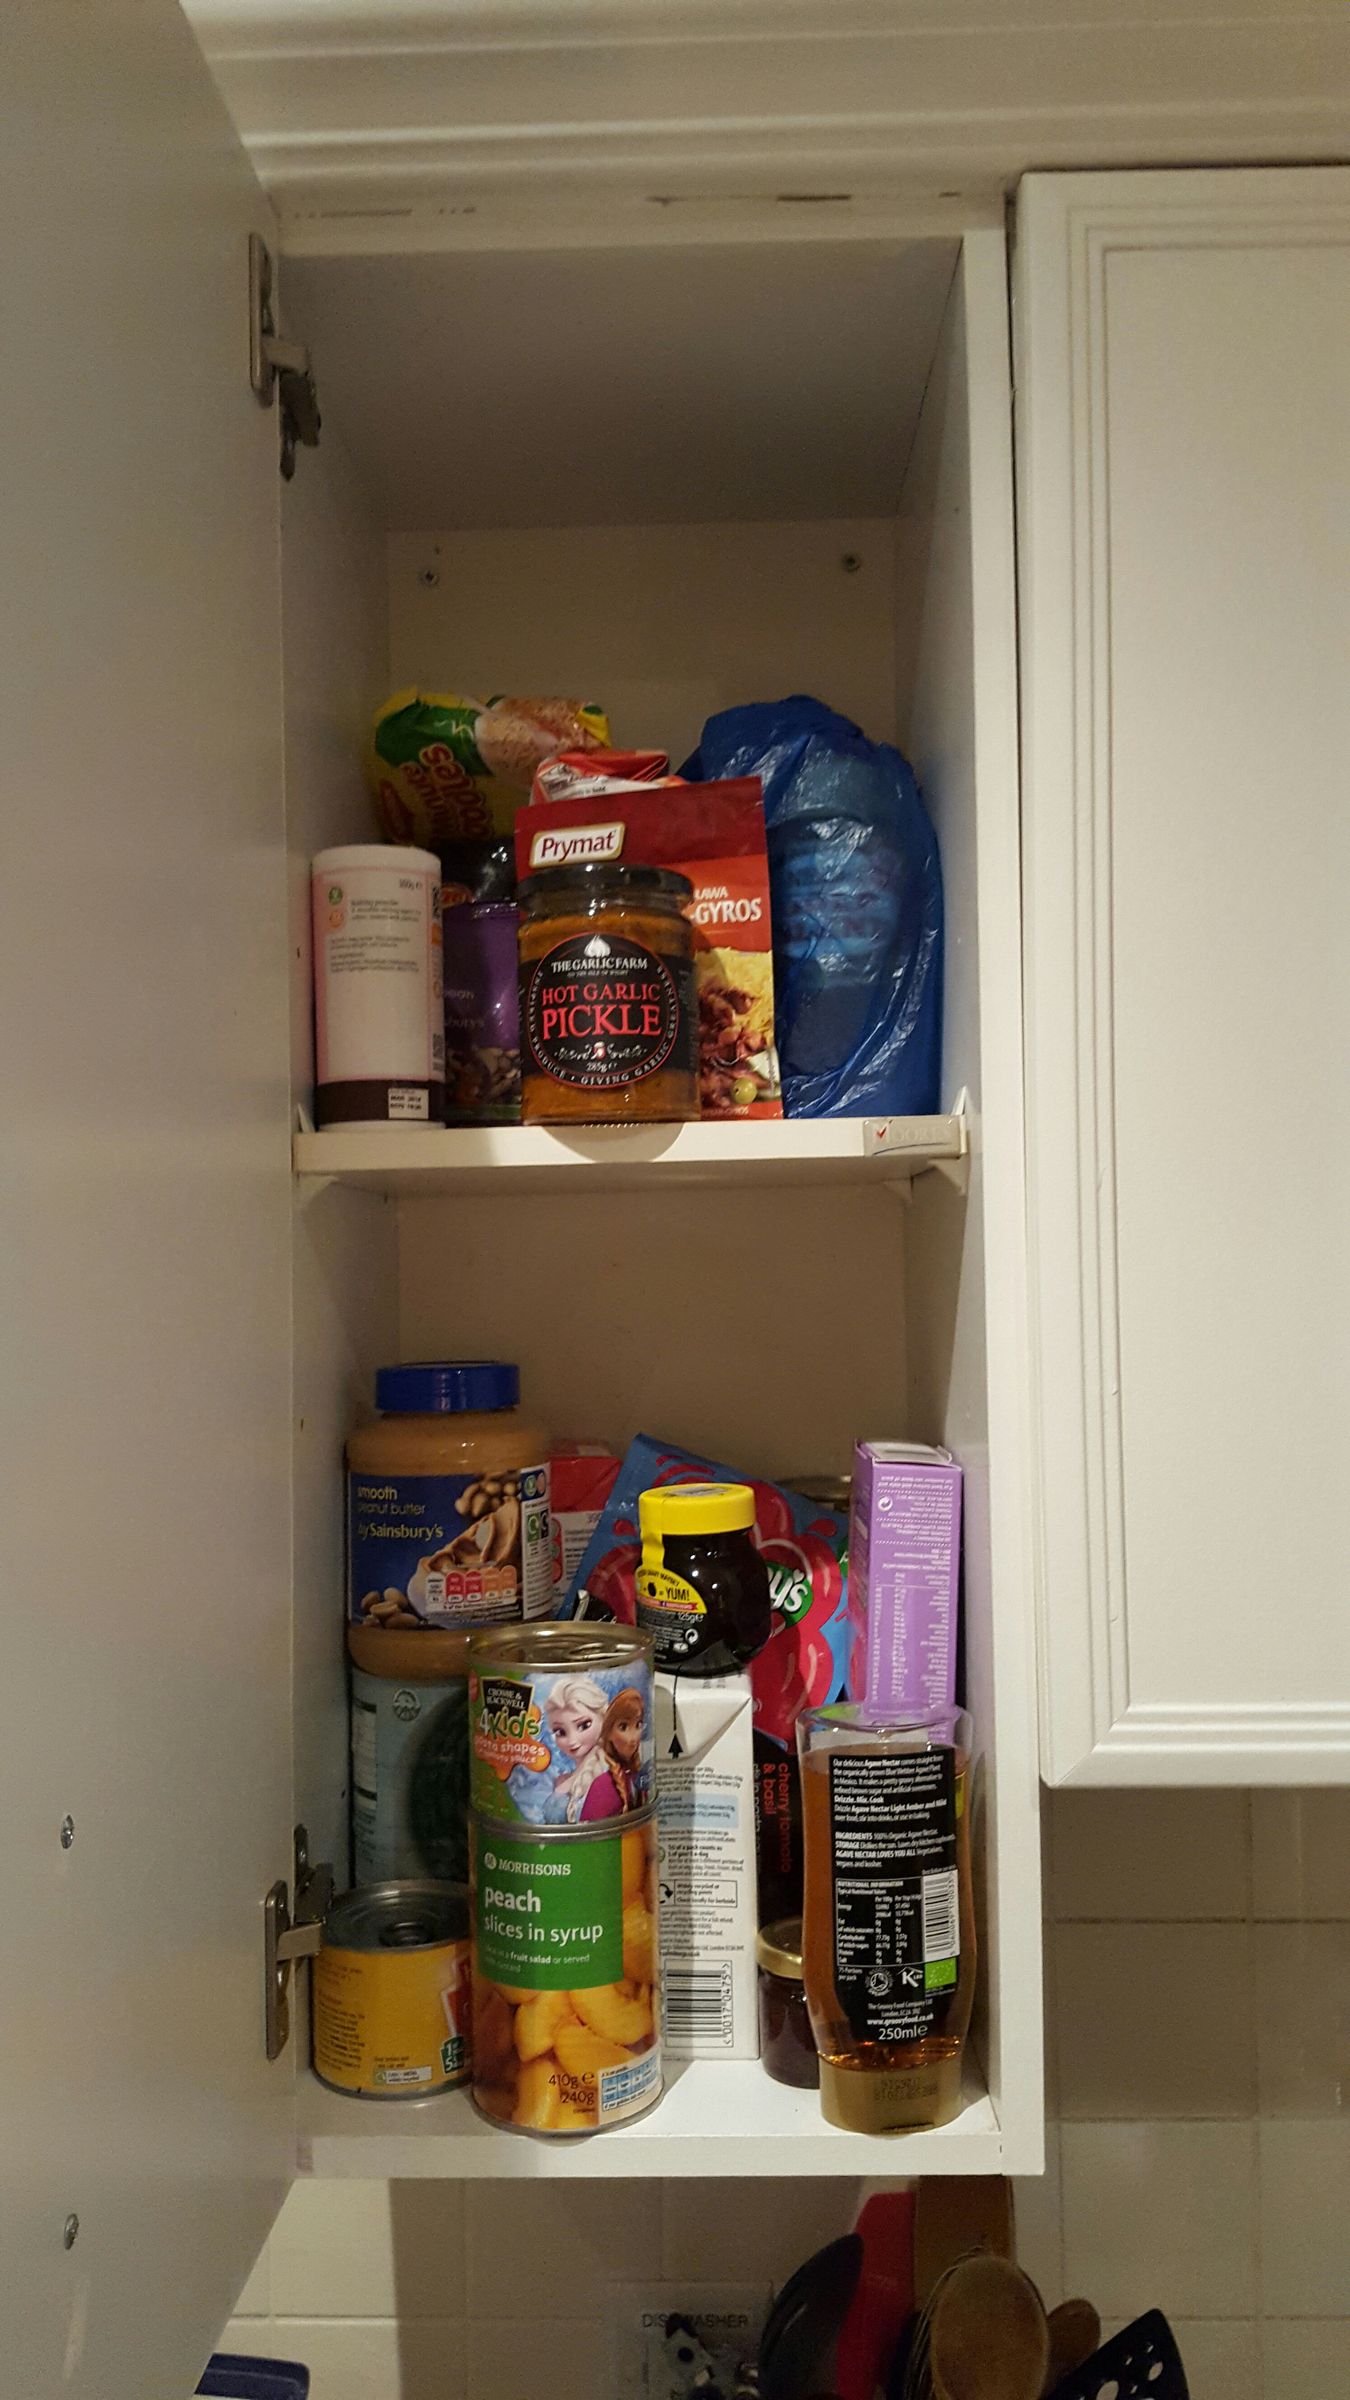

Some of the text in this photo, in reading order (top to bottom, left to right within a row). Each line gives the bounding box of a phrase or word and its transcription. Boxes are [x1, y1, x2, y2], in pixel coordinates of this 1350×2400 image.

[541, 835, 614, 862] Prymat
[551, 956, 649, 974] THE GARLIC FARM
[542, 983, 661, 1006] HOT GARLIC
[542, 1004, 663, 1041] PICKLE
[580, 1072, 631, 1086] GIVING
[634, 1041, 670, 1076] GARLIC
[370, 1522, 444, 1542] Sainsbury's
[666, 1586, 691, 1602] YUM!
[501, 1740, 546, 1757] shapes
[763, 1779, 777, 1815] basil
[778, 1762, 793, 1873] cherry tomato
[835, 1831, 873, 1841] INGREDIENTS
[835, 1840, 860, 1850] STORAGE
[835, 1848, 917, 1859] AGAVE NECTAR LOVES YOU ALL
[498, 1859, 571, 1876] MORRISONS
[485, 1886, 541, 1913] peach
[485, 1914, 603, 1947] slices in syrup
[510, 1951, 529, 1963] fruit
[529, 1954, 552, 1965] salad
[553, 1956, 562, 1964] or
[563, 1953, 590, 1965] served
[548, 2075, 579, 2095] 410g
[559, 2090, 596, 2106] 240g
[641, 2311, 750, 2330] DISASHER
